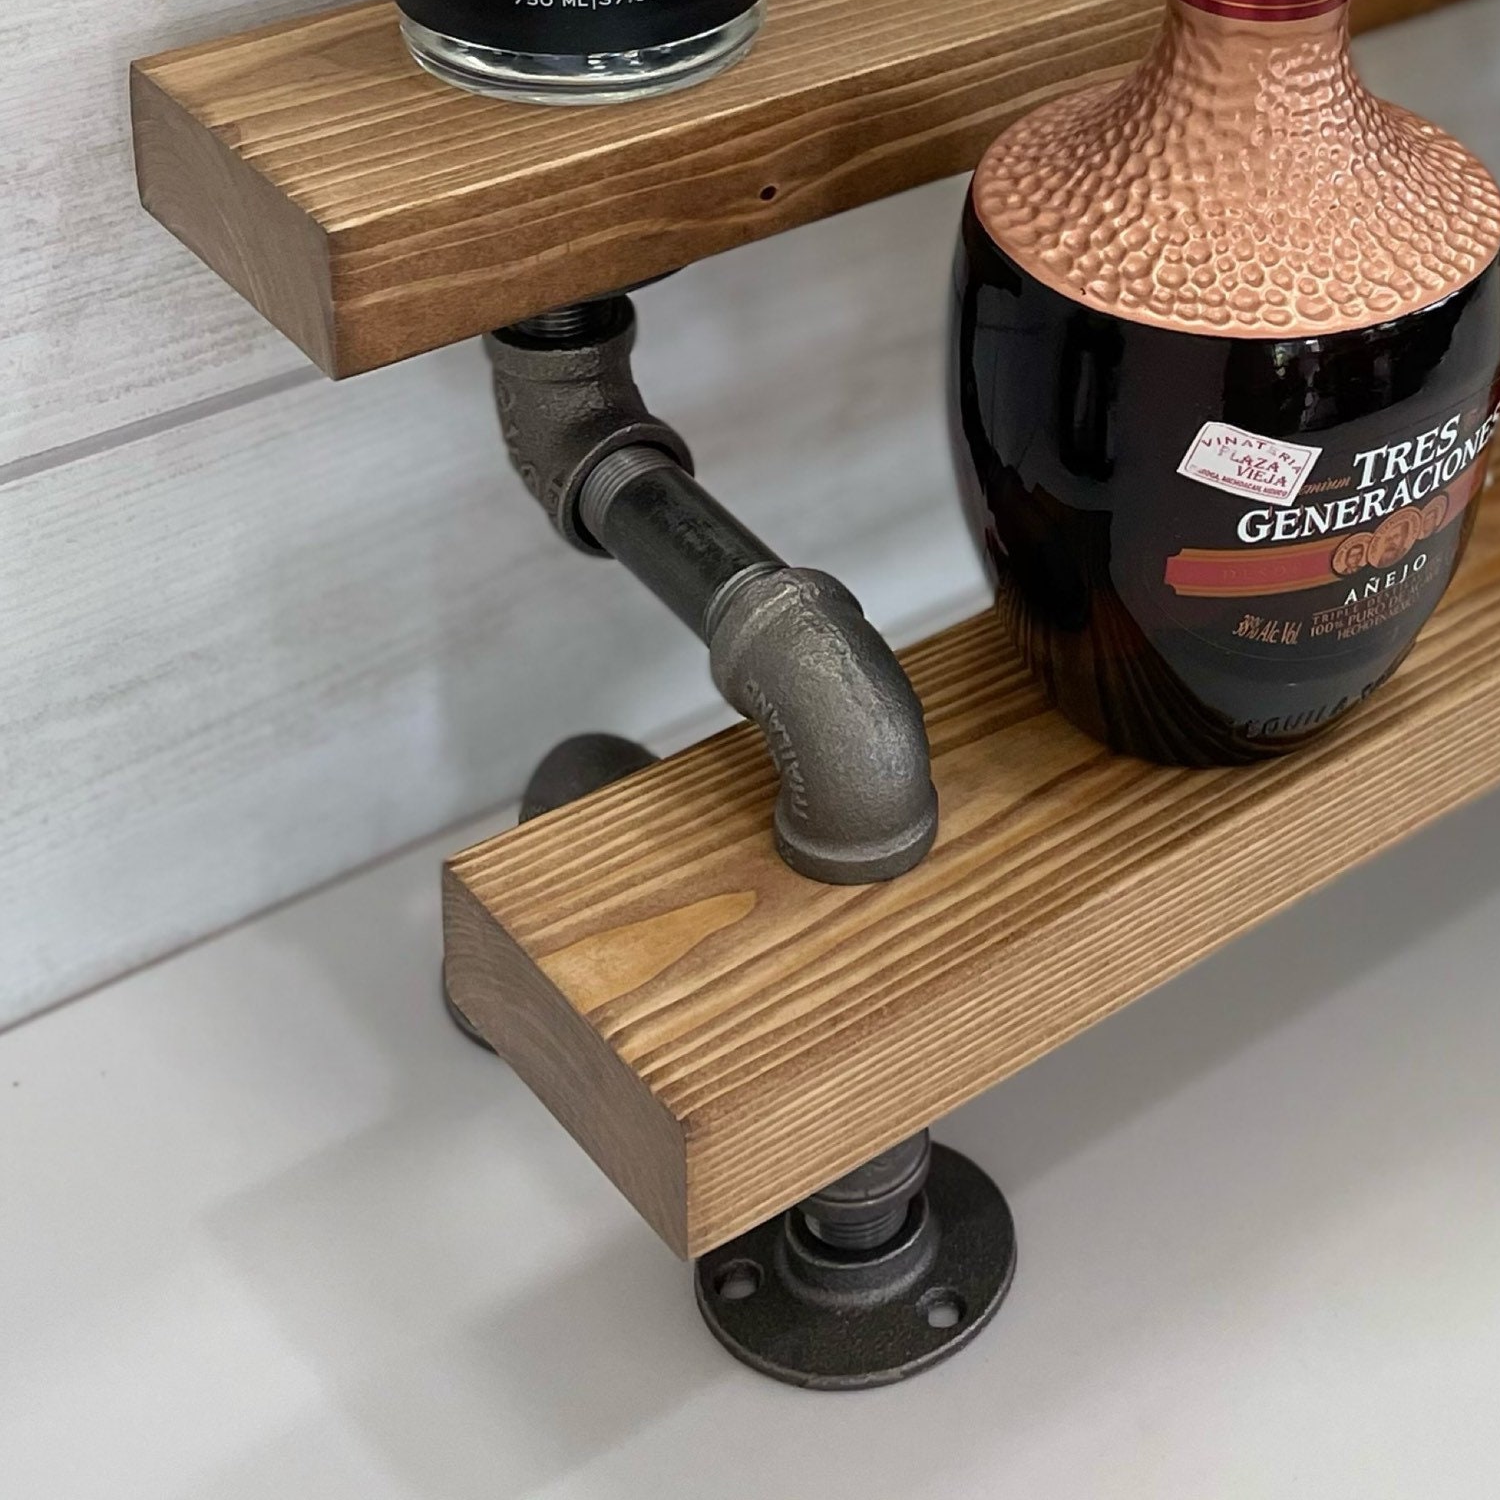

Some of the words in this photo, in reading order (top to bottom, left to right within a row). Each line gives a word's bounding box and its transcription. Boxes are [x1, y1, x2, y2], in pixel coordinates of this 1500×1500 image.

[1217, 445, 1280, 474] PLAZA
[1352, 413, 1462, 490] TRES
[1236, 465, 1289, 488] VIEJA
[1343, 553, 1428, 607] AÑEJO
[1347, 602, 1387, 627] PURO
